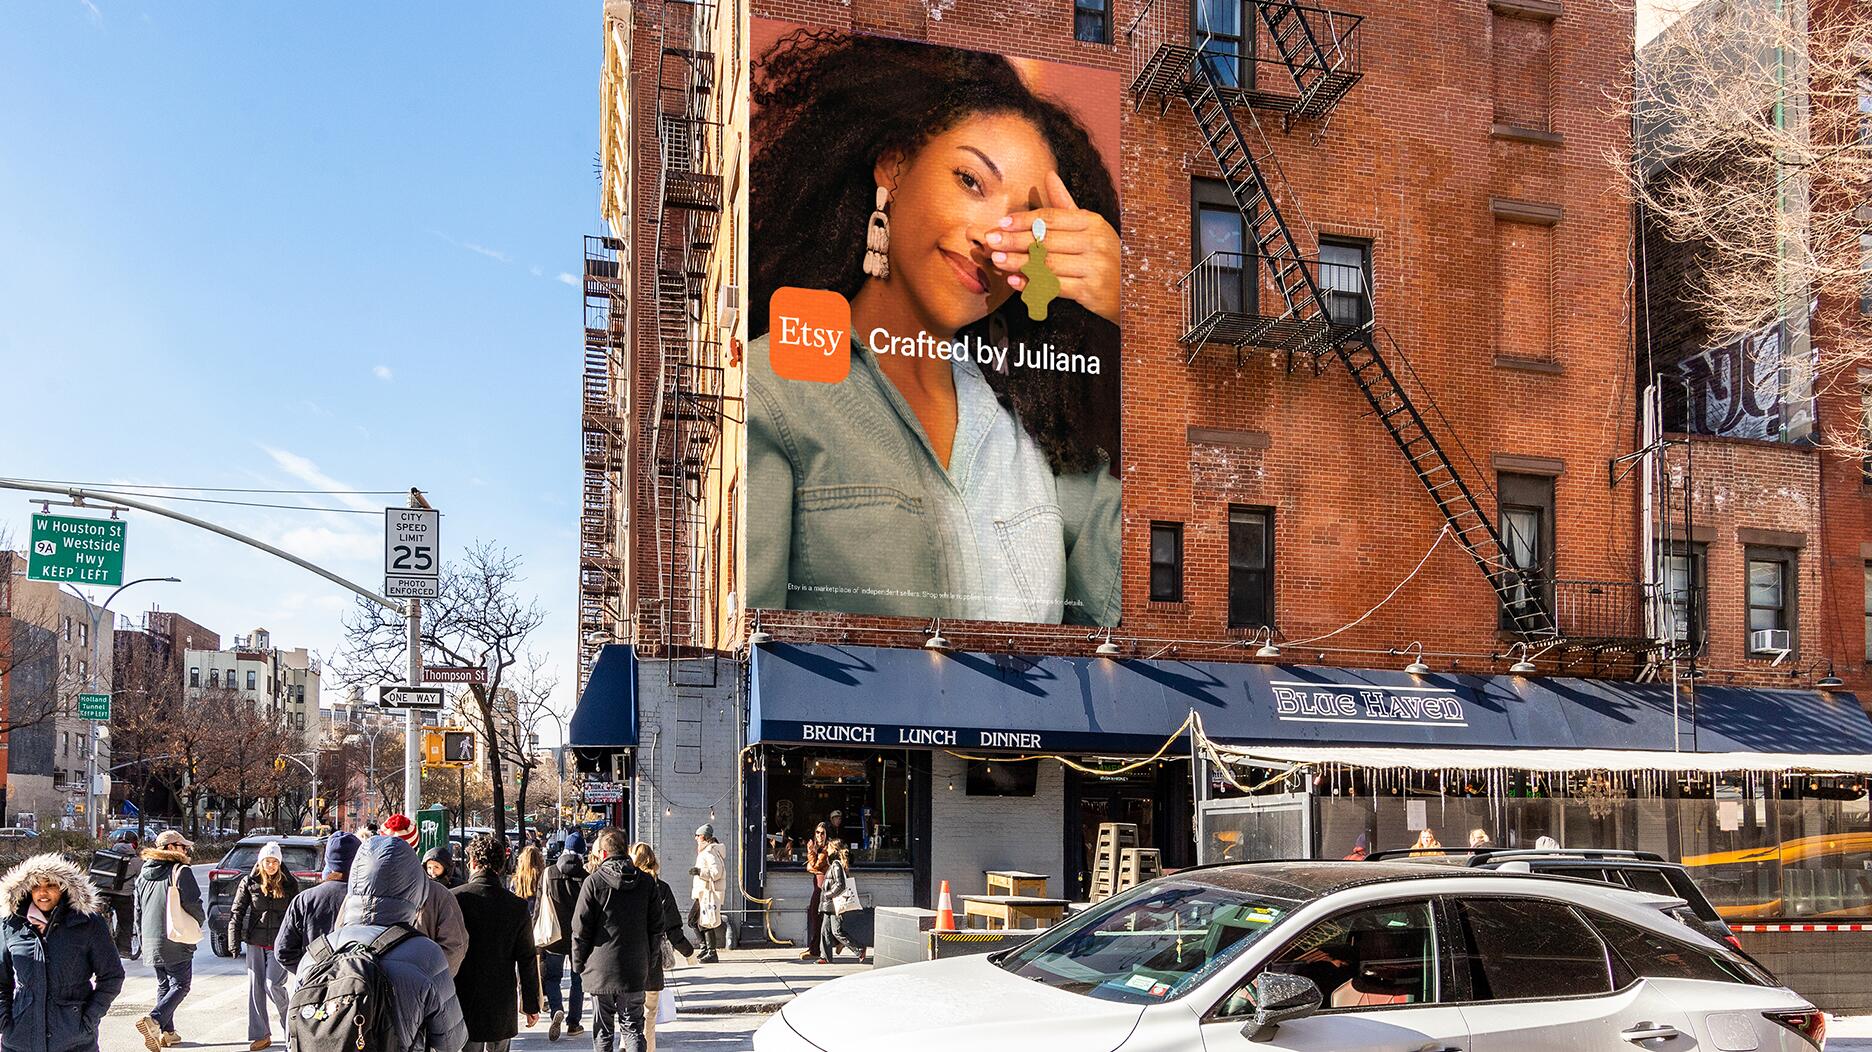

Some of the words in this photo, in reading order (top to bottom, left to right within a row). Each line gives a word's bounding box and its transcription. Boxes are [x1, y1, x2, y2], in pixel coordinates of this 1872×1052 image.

[778, 315, 844, 356] Etsy
[869, 327, 970, 362] Crafted
[976, 336, 1008, 371] by
[1013, 342, 1101, 375] Juliana
[401, 512, 423, 521] CITY
[37, 519, 48, 531] W
[52, 521, 105, 536] Houston
[109, 525, 122, 537] St
[396, 522, 428, 532] SPEED
[63, 536, 121, 552] Westside
[399, 533, 425, 542] LIMIT
[37, 542, 53, 553] 9A
[76, 552, 105, 568] Hwy
[392, 545, 433, 571] 25
[42, 565, 74, 578] KEEP
[80, 568, 109, 581] LEFT
[398, 579, 426, 588] PHOTO
[787, 583, 801, 591] Etsy
[802, 583, 808, 591] is
[814, 585, 851, 594] marketplace
[852, 586, 860, 594] of
[861, 587, 899, 596] ndependent
[390, 587, 434, 596] ENFORCED
[424, 669, 472, 682] Thompson
[475, 670, 485, 681] St
[389, 693, 408, 702] ONE
[416, 693, 436, 703] WAY
[802, 724, 875, 743] BRUNCH
[899, 728, 957, 745] LUNCH
[980, 731, 1042, 749] DINNER
